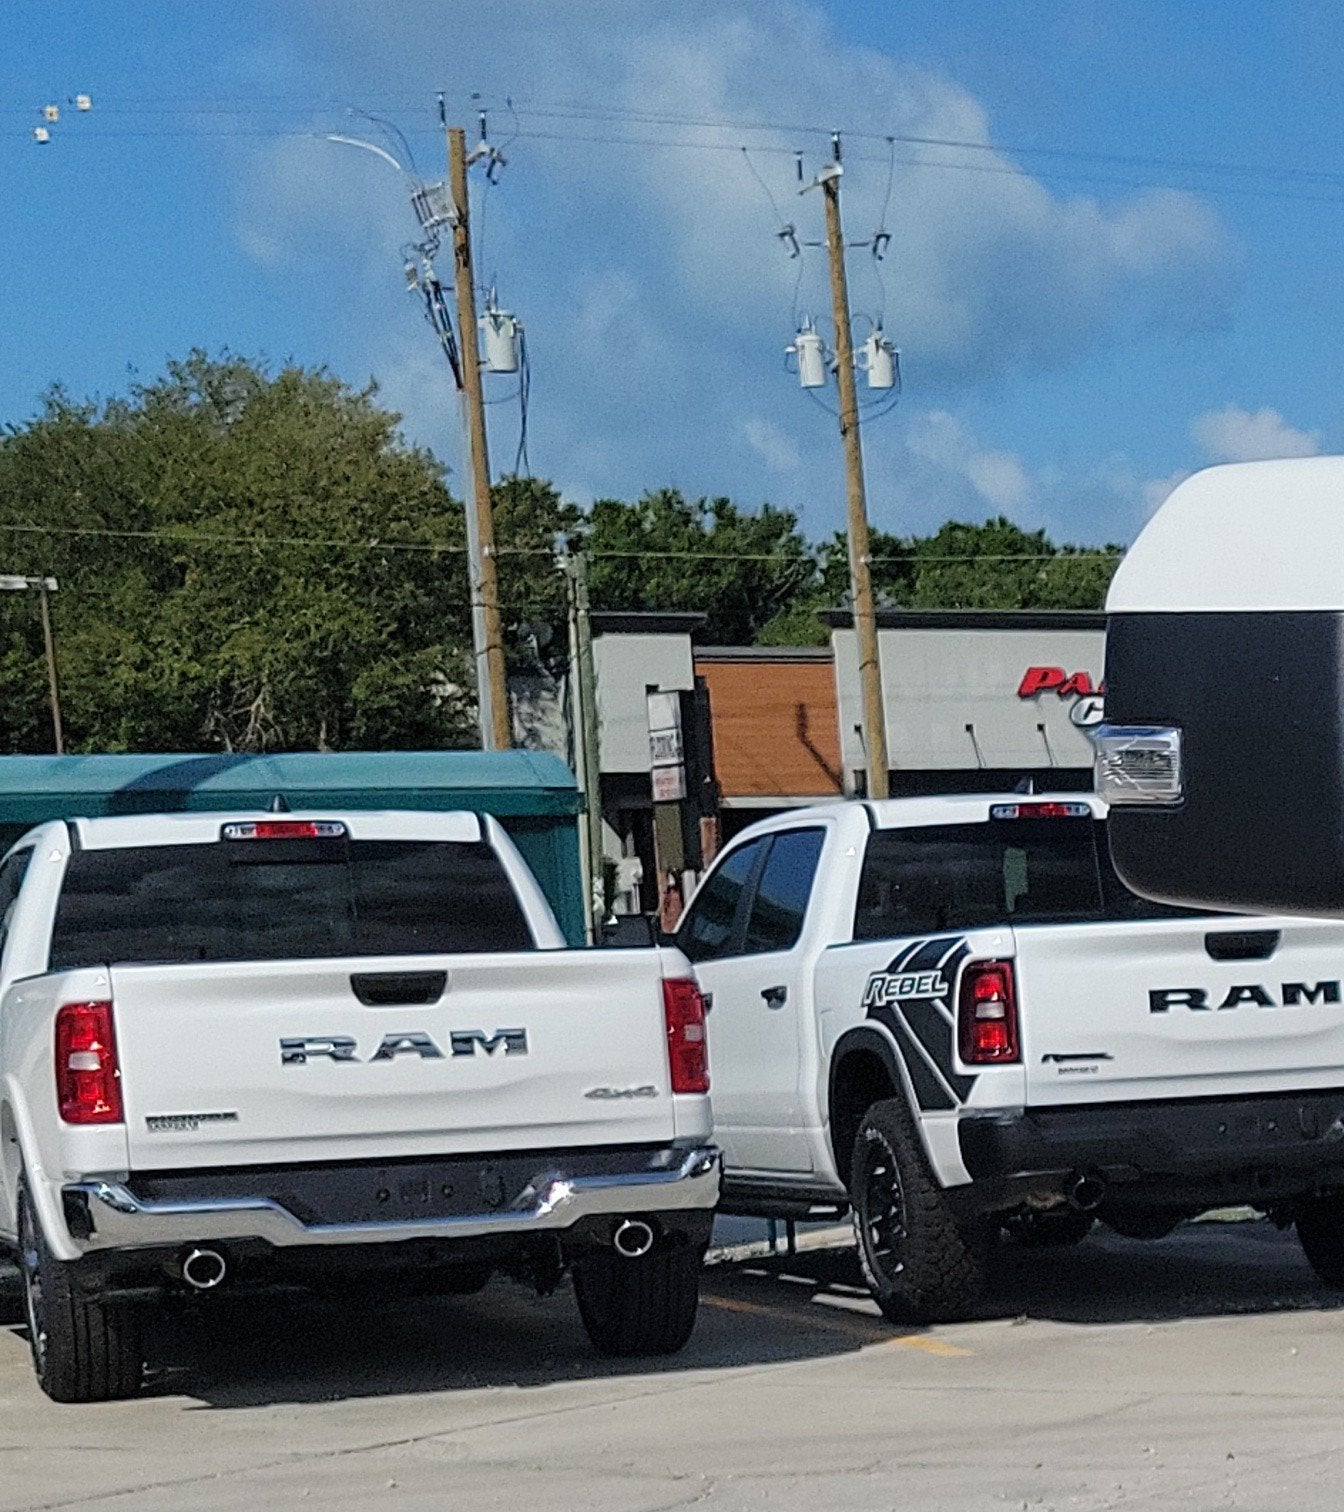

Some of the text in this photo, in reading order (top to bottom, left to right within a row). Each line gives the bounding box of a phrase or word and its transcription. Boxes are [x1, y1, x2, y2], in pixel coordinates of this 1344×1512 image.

[1018, 667, 1105, 698] PA
[861, 970, 949, 1008] REBEL
[1148, 980, 1342, 1013] RAM
[279, 1027, 528, 1066] RAM
